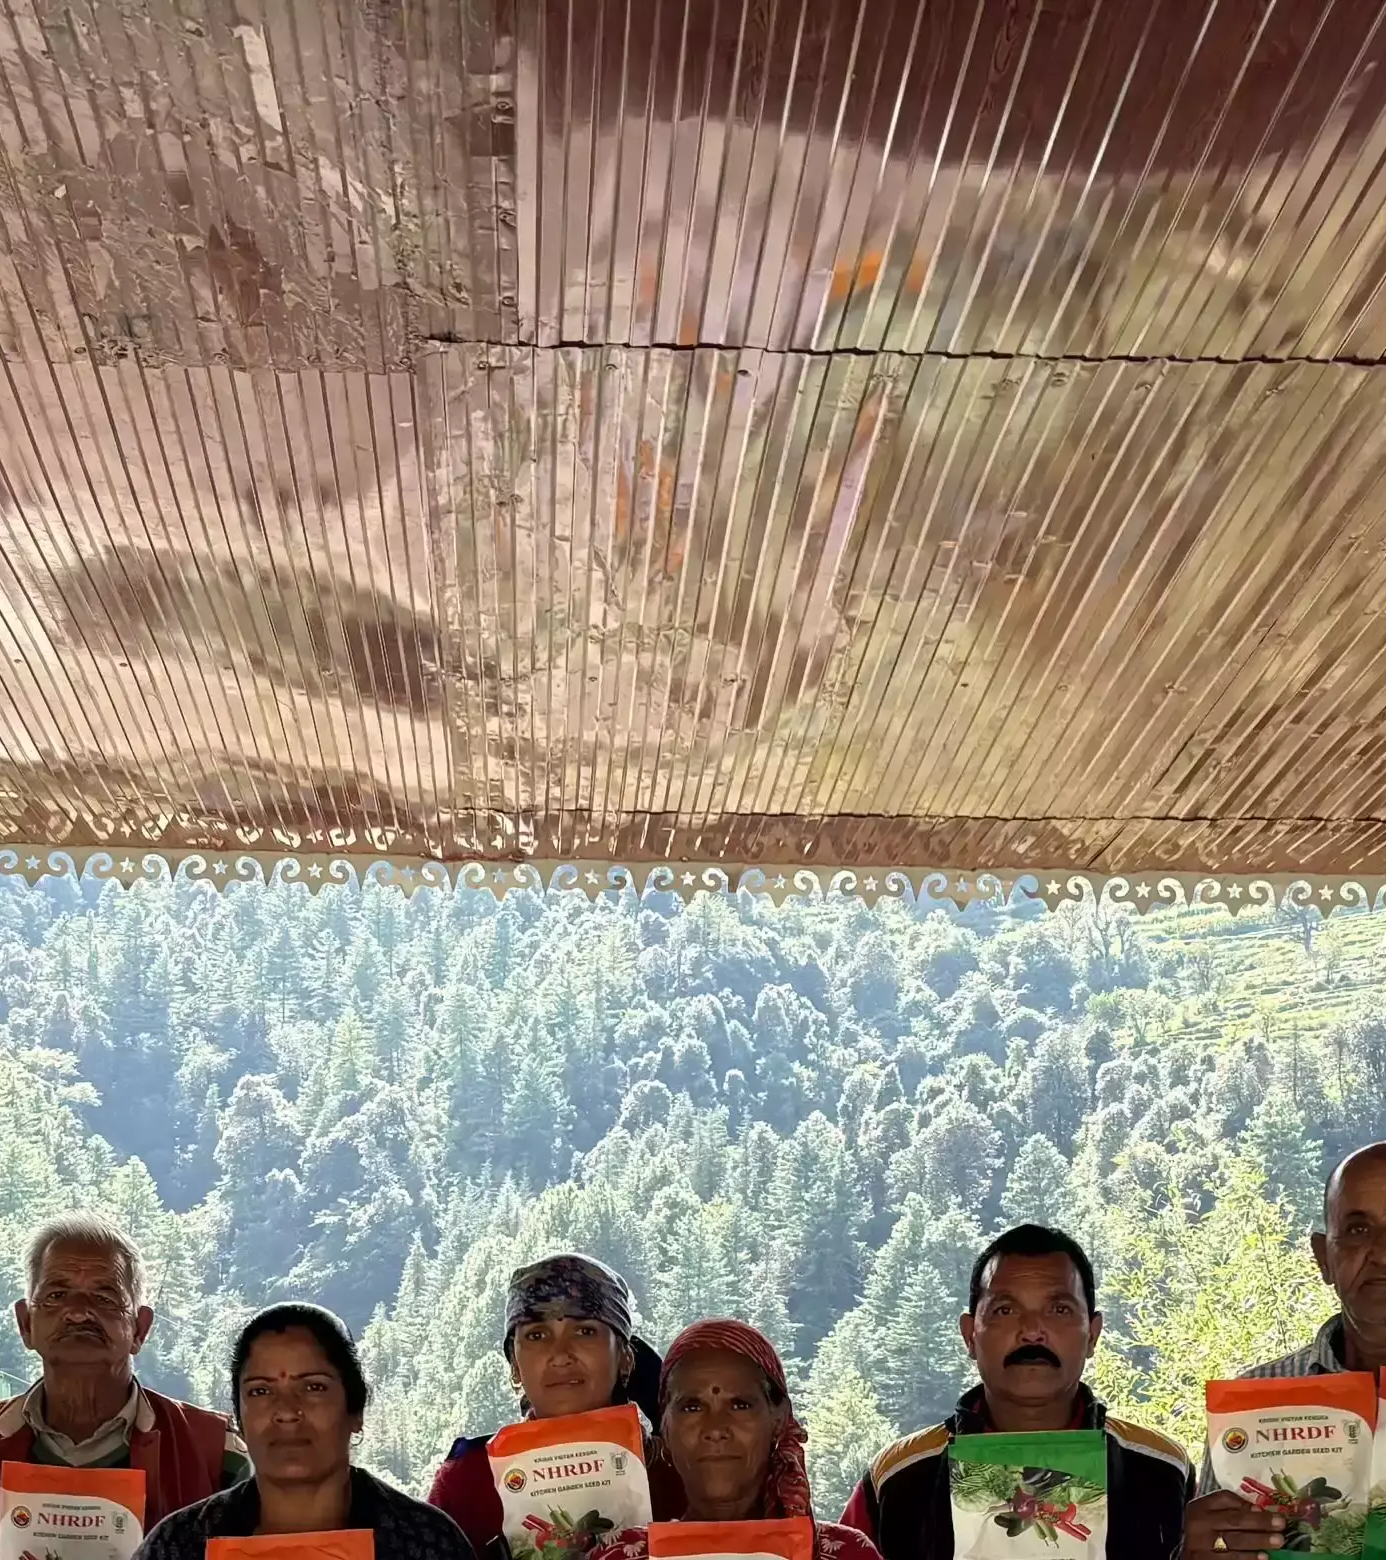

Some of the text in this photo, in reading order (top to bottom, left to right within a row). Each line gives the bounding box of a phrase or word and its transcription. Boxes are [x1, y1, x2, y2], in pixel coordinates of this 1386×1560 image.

[1256, 1425, 1336, 1443] NHRDF
[533, 1459, 604, 1482] NHRDF
[37, 1512, 105, 1527] NHRDF
